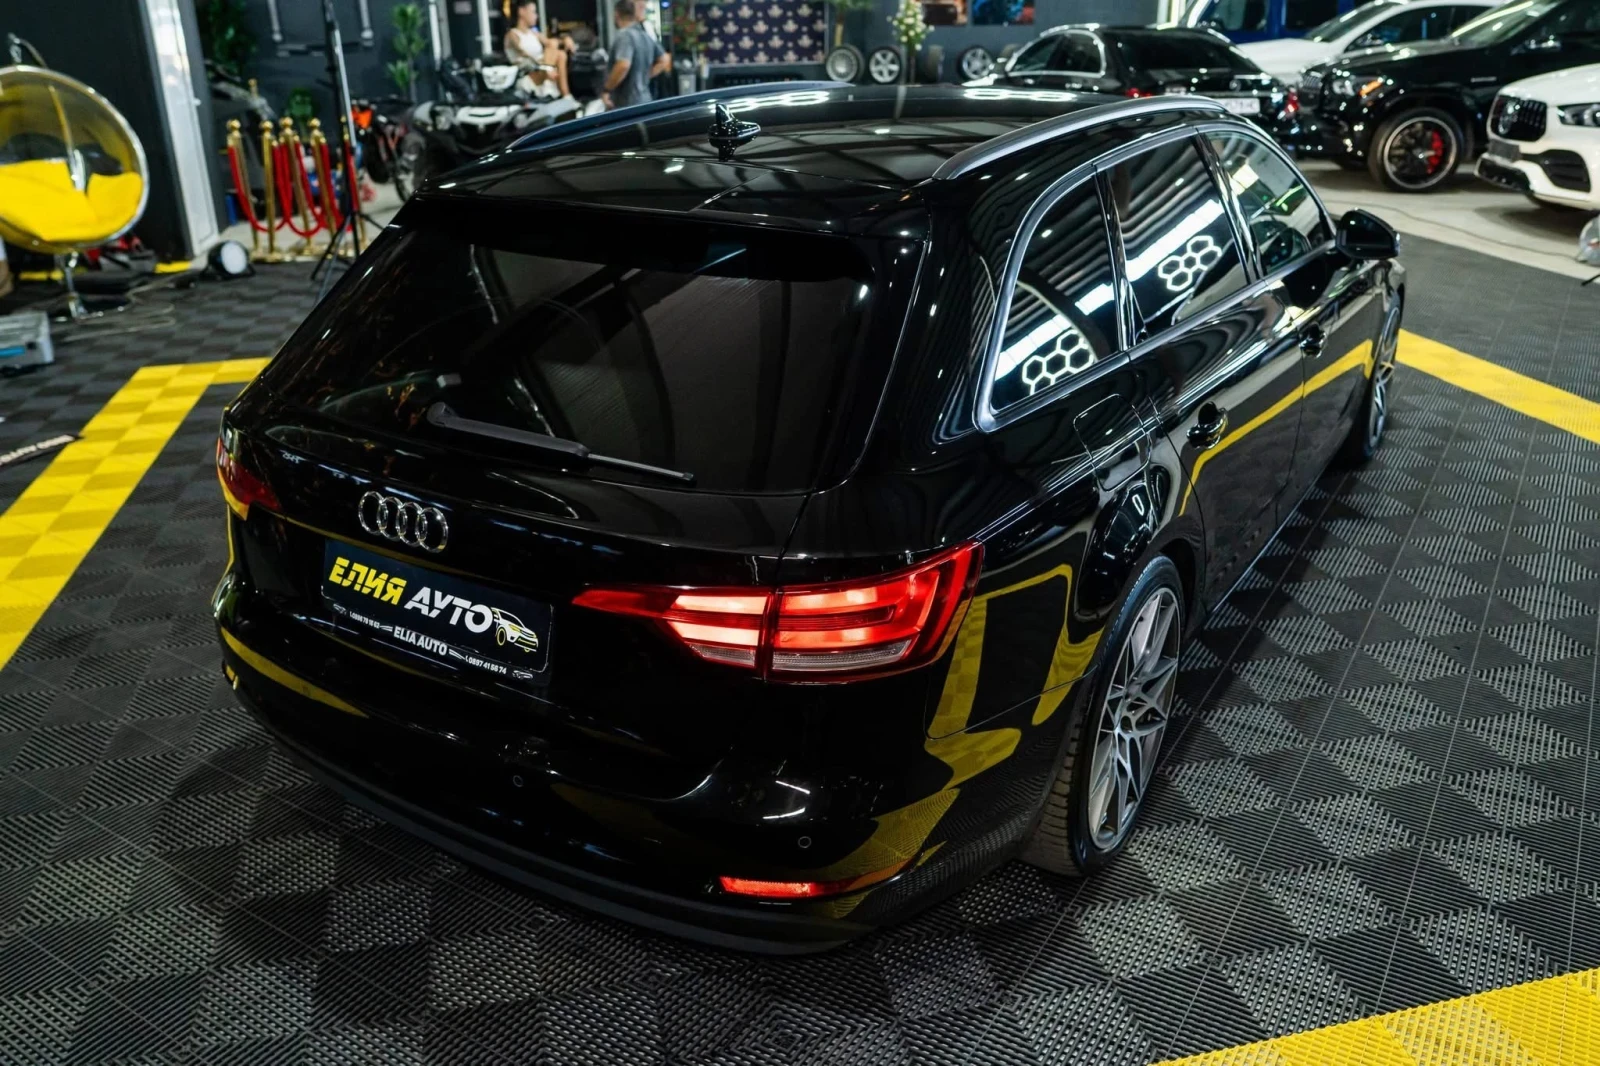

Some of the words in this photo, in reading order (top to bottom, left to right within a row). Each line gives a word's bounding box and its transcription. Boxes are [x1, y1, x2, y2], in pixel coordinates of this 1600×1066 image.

[328, 556, 407, 606] ЕЛИЯ
[394, 625, 416, 646] ELIA
[416, 634, 448, 656] AUTO
[483, 661, 491, 670] 41
[498, 666, 507, 675] 74
